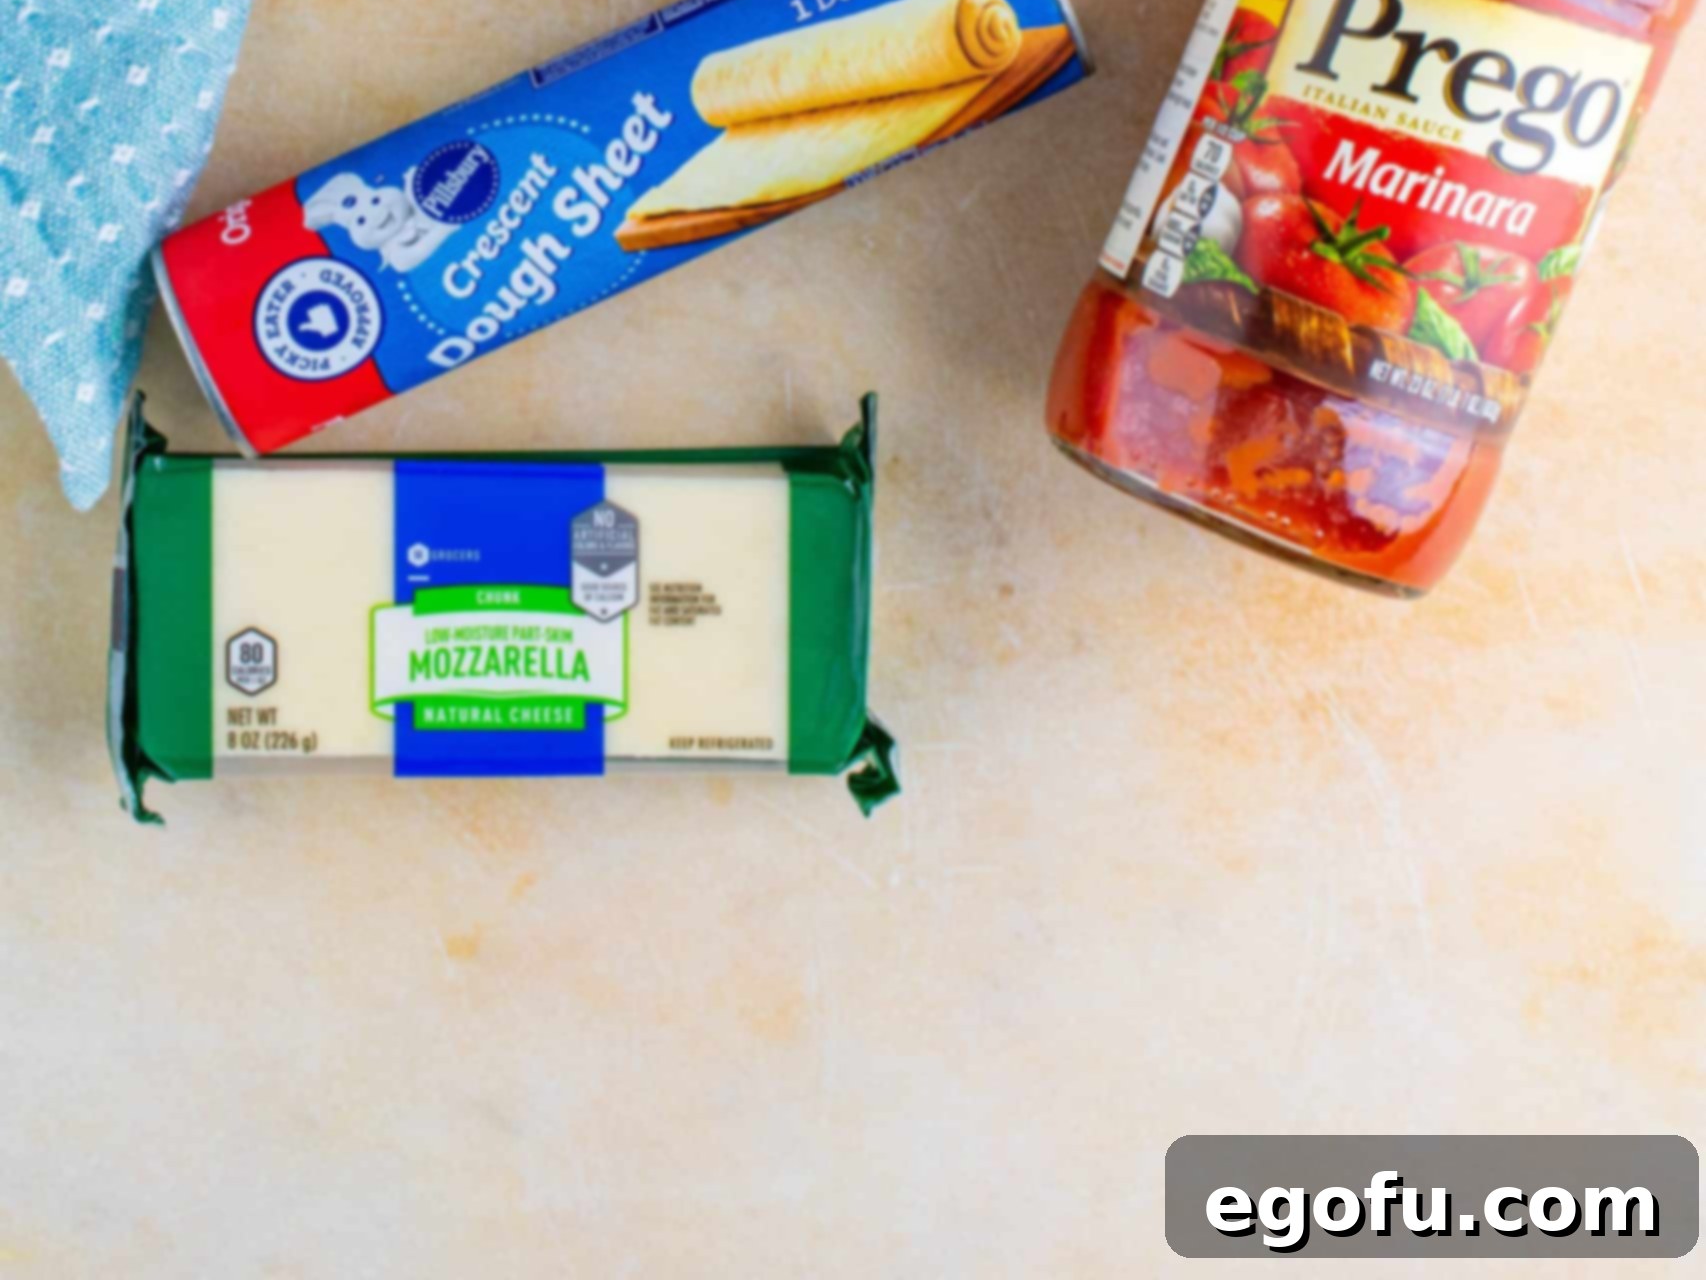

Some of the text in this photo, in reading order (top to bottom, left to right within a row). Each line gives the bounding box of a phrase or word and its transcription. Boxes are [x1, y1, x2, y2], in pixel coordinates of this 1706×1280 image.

[1302, 84, 1466, 144] ITALIAN SAUCE
[421, 143, 491, 218] Pillsbury
[1322, 137, 1537, 237] Marinara
[426, 232, 572, 368] Dough
[552, 89, 673, 238] Sheet
[442, 151, 557, 299] Crescent
[264, 278, 296, 340] EATER
[319, 269, 373, 350] APPROVED
[274, 343, 333, 372] PICKY
[593, 509, 616, 528] NO
[475, 589, 522, 606] CHUNK
[239, 641, 264, 664] 80
[408, 645, 591, 683] MOZZARELLA
[226, 706, 278, 726] NET WT
[422, 706, 574, 724] NATURAL CHEESE
[227, 730, 318, 754] 8 OZ (226 g)
